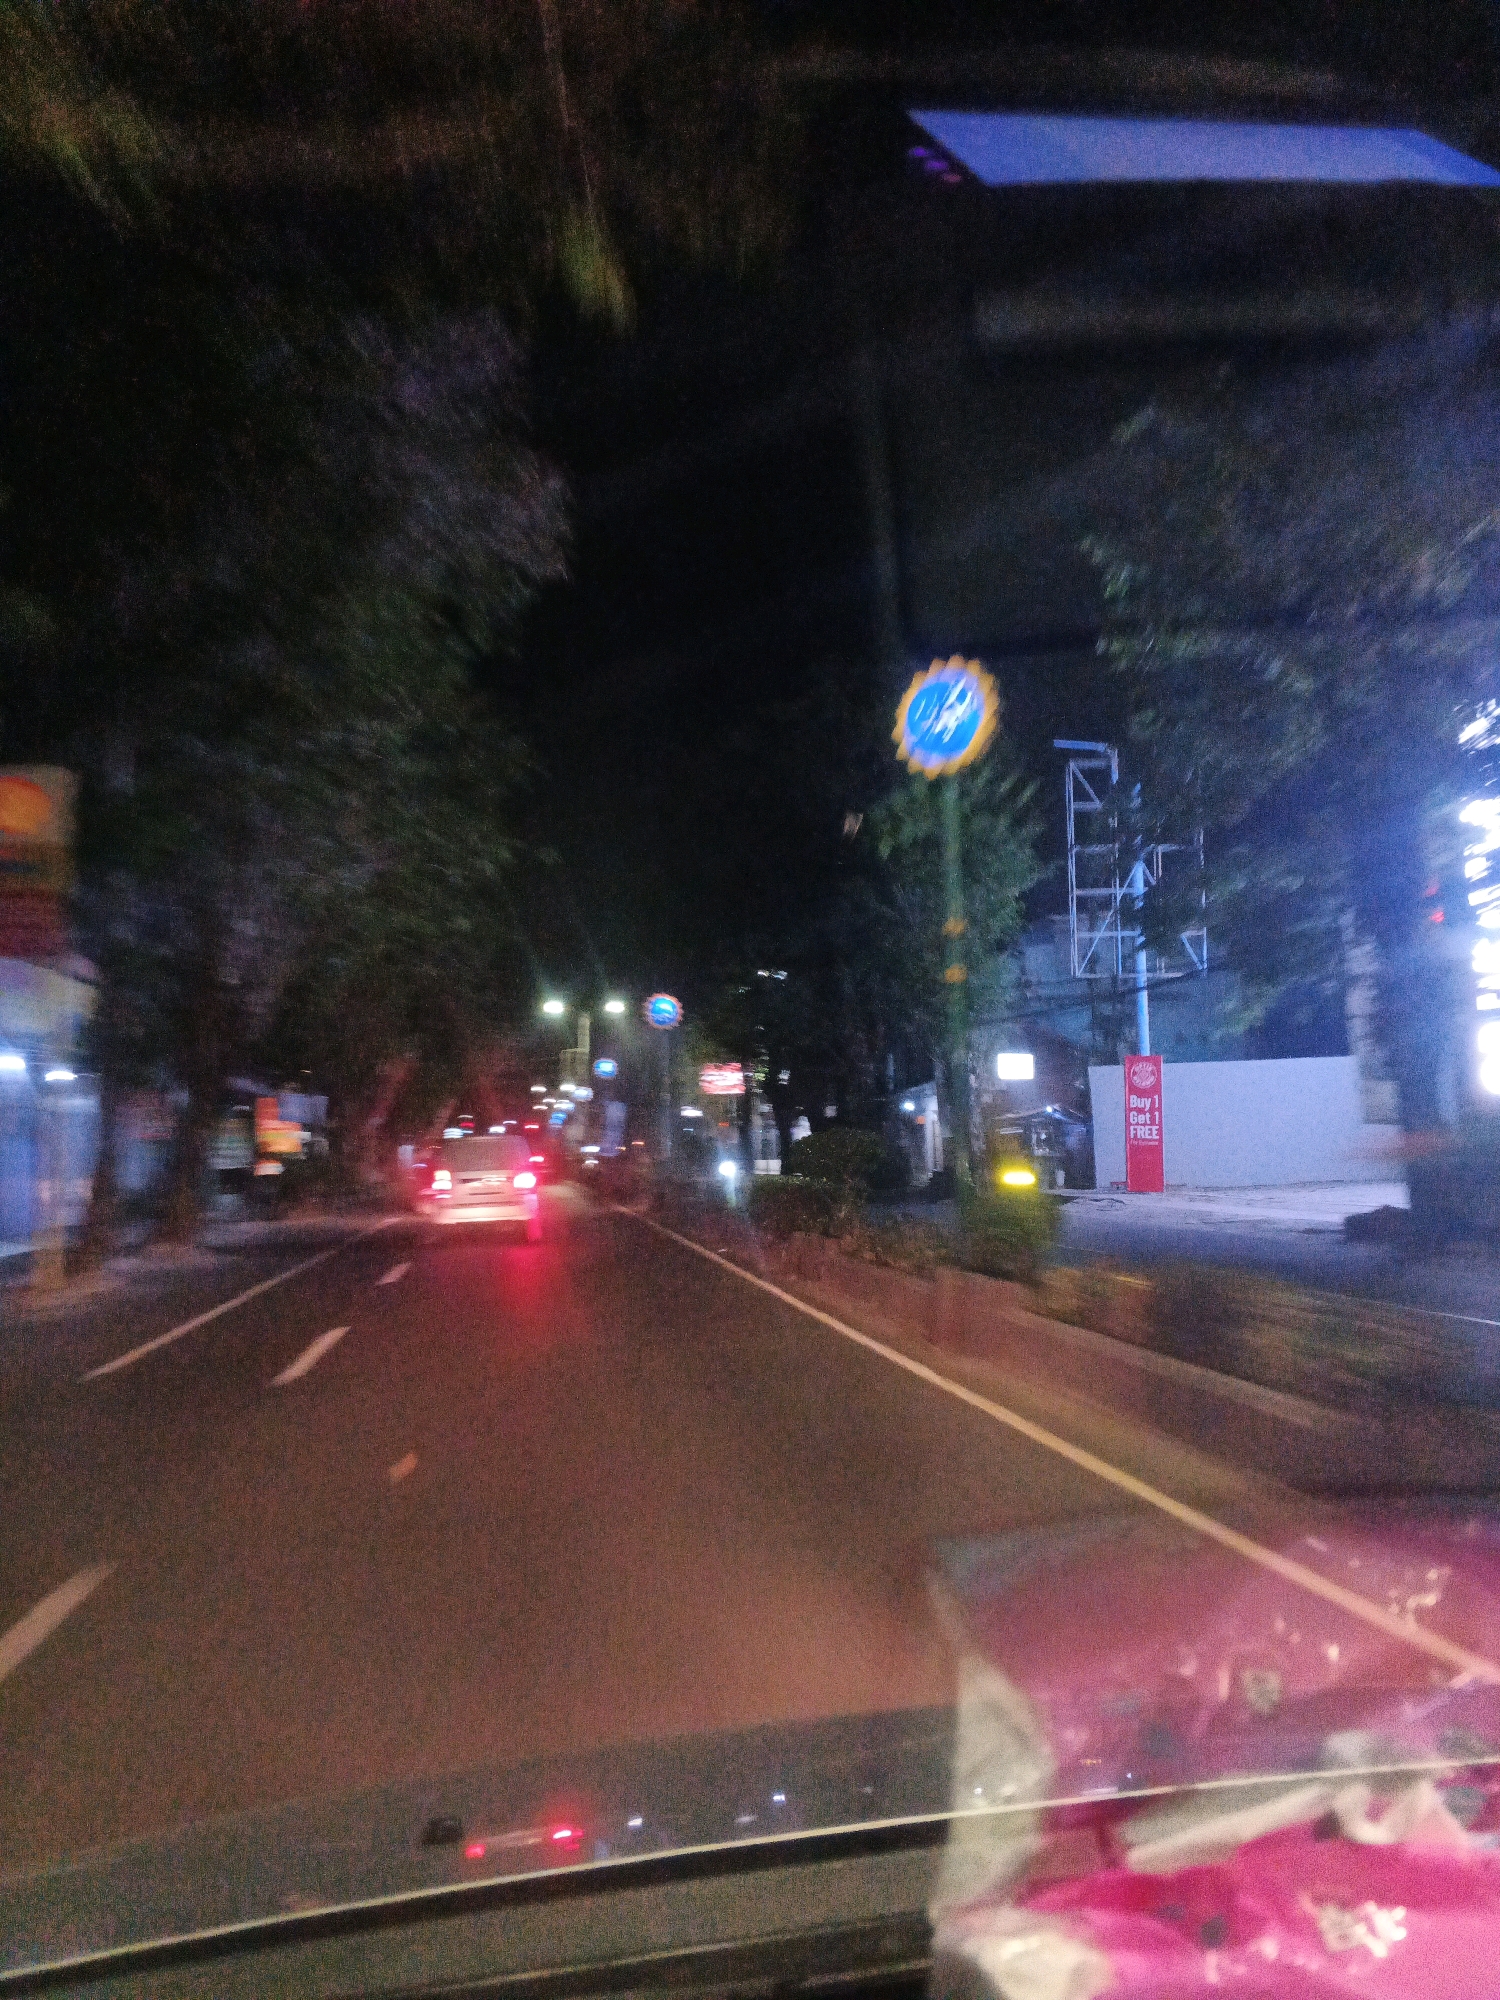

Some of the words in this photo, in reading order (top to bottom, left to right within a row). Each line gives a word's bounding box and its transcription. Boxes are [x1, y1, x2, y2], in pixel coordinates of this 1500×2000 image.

[1130, 1094, 1152, 1111] Buy
[1154, 1094, 1159, 1108] 1
[1130, 1111, 1151, 1124] Get
[1154, 1111, 1159, 1124] 1
[1130, 1125, 1160, 1139] FREE
